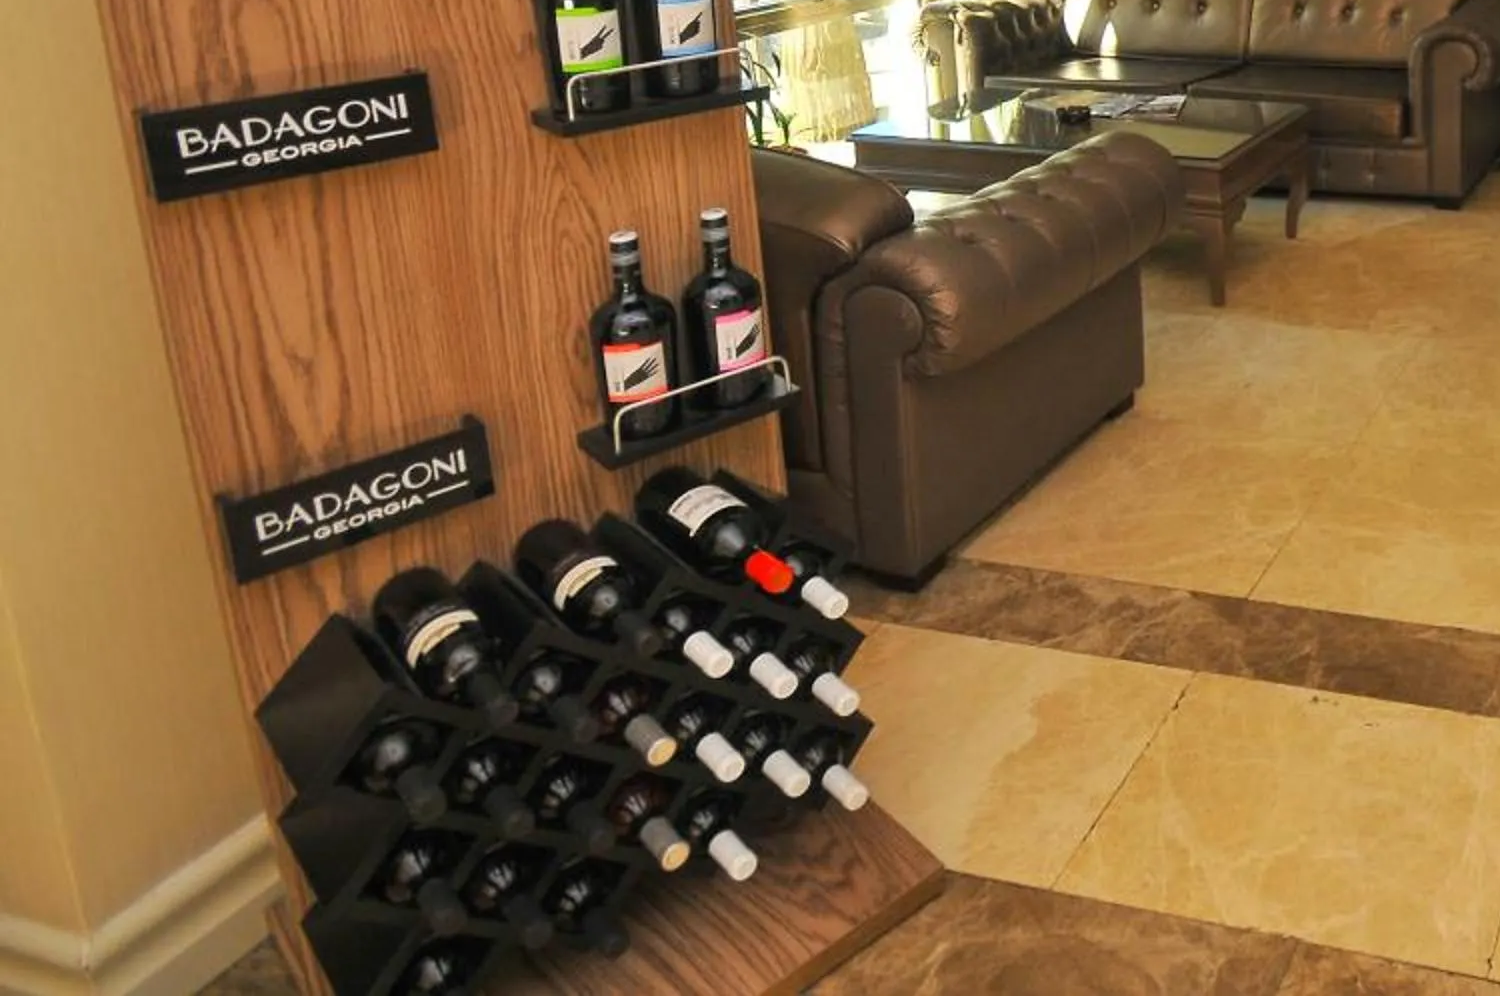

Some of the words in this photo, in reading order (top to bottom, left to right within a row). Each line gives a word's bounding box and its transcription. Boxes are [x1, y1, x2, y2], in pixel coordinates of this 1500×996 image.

[175, 92, 409, 159] BADAGONI
[240, 134, 364, 167] GEORGIA
[254, 447, 468, 543] BADAGONI
[312, 494, 426, 541] GEORGIA
